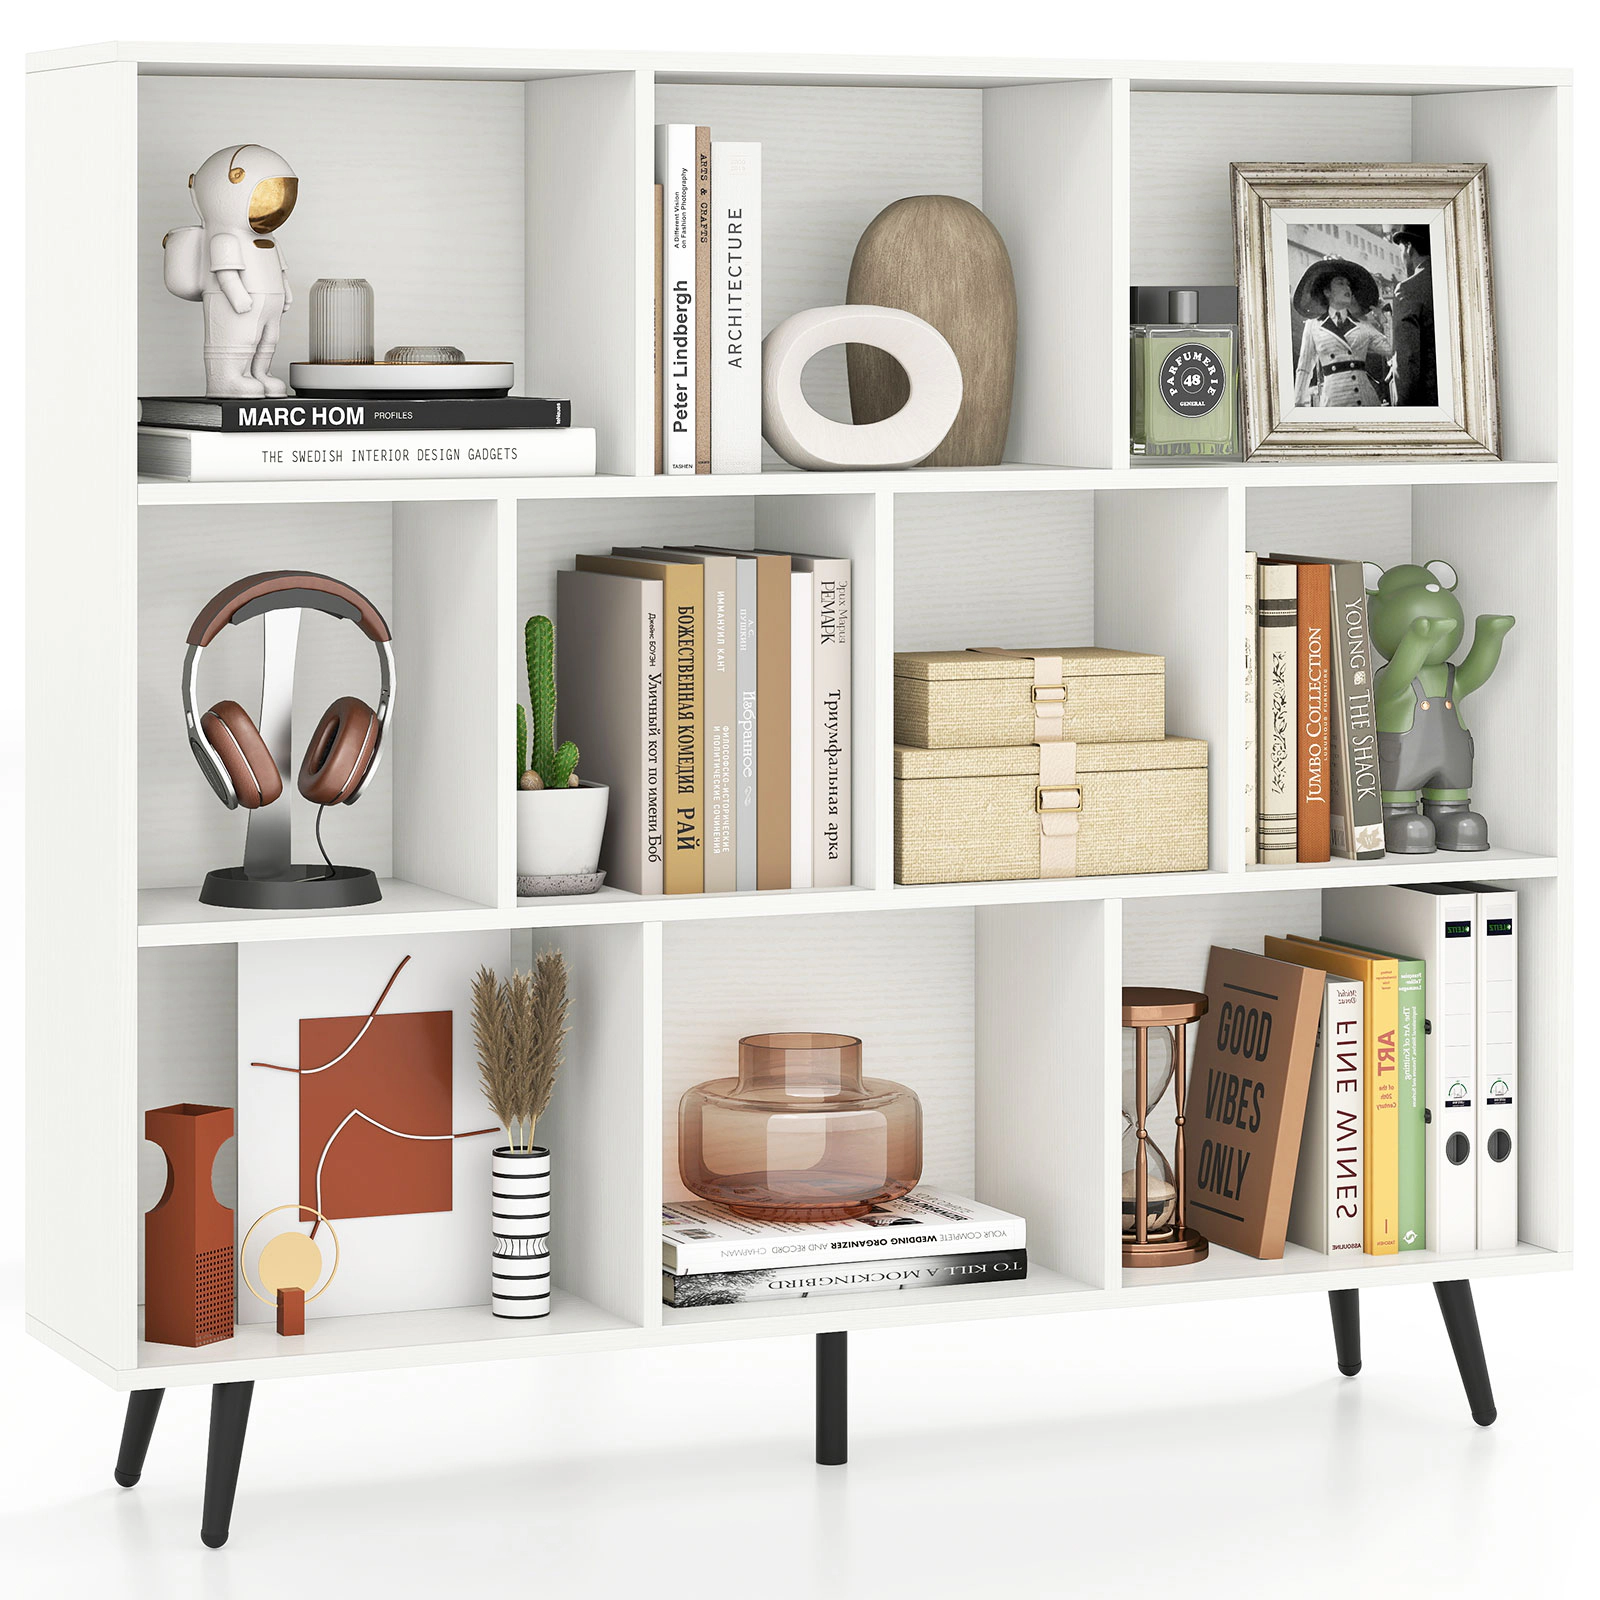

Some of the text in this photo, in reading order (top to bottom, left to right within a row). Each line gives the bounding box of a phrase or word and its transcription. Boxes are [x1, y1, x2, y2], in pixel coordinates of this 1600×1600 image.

[700, 154, 708, 244] ARTS & CRAFTS
[728, 208, 742, 368] ARCHITECTURE
[673, 280, 692, 432] Peter Lindbergh
[1166, 352, 1218, 396] PARFUMERIE
[1183, 374, 1201, 387] 48
[238, 406, 413, 428] MARC HOM PROFILES
[262, 447, 518, 464] THE SWEDISH INTERIOR DESIGN GADGETS
[717, 590, 725, 673] ИММАНУИЛ КАНТ
[821, 580, 836, 645] РЕМАРК
[836, 580, 848, 644] Эрих Мария
[1345, 596, 1366, 670] YOUNG
[649, 641, 657, 667] БОУЭН
[675, 606, 700, 851] БОЖЕСТВЕННАЯ КОМЕДИЯ РАЙ
[738, 690, 757, 778] Избранное
[1306, 627, 1326, 804] JUMBO COLLECTION
[1350, 688, 1376, 802] THE SHACK
[648, 672, 662, 863] Уличный кот по имени Боб
[713, 735, 721, 801] ПОЛИТИЧЕСКИЕ
[722, 725, 730, 853] ФИЛОСОФСКО-ИСТОРИЧЕСКИЕ
[824, 689, 842, 860] Триумфальная арка
[713, 804, 721, 854] СОЧИНЕНИЯ
[1216, 1000, 1273, 1063] GOOD
[1204, 1068, 1265, 1134] VIBES
[1198, 1138, 1251, 1202] ONLY
[720, 1230, 1008, 1258] YOUR COMPLETE WEDDING ORGANIZER AND RECORD CHAPMAN
[768, 1261, 1023, 1290] TO KILL A MOCKINGBIRD
